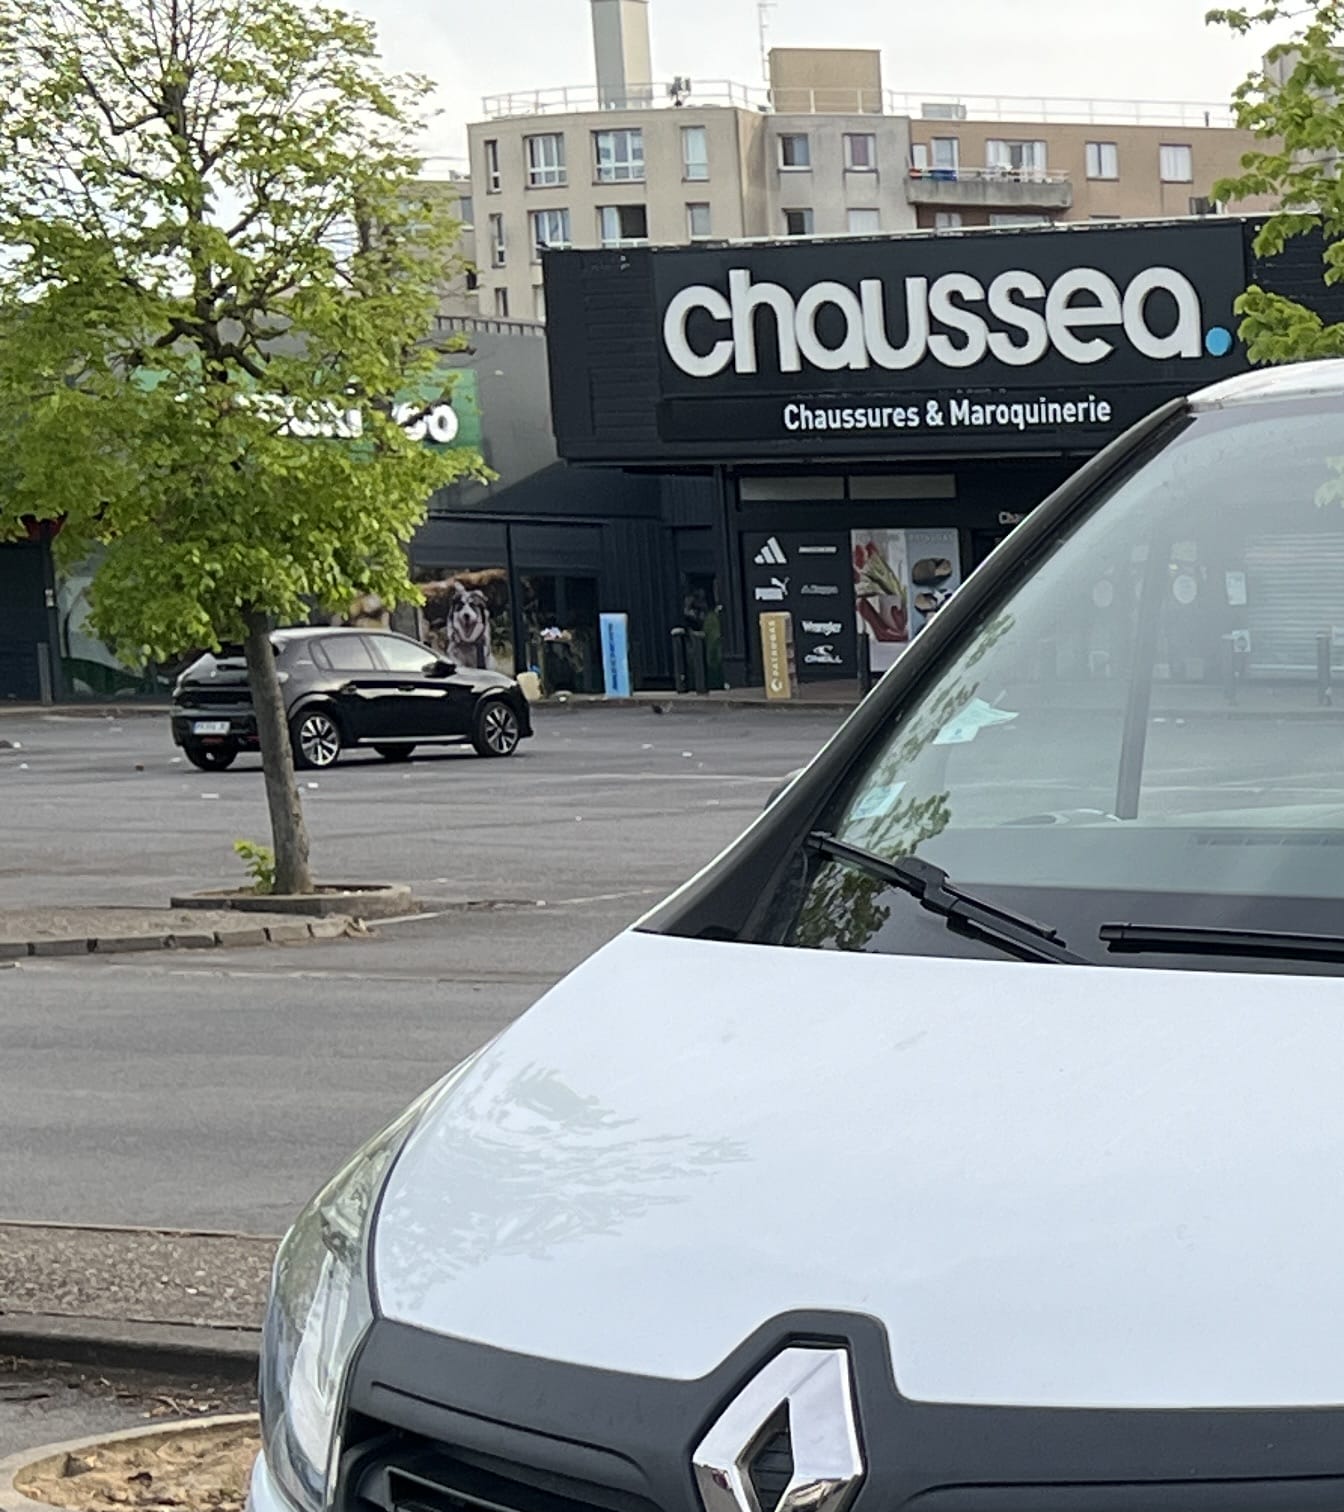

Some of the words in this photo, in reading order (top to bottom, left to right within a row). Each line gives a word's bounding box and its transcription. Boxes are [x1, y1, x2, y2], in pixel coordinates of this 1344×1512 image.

[784, 403, 920, 430] Chaussures
[925, 399, 944, 427] &
[950, 394, 1111, 430] Maroquinerie
